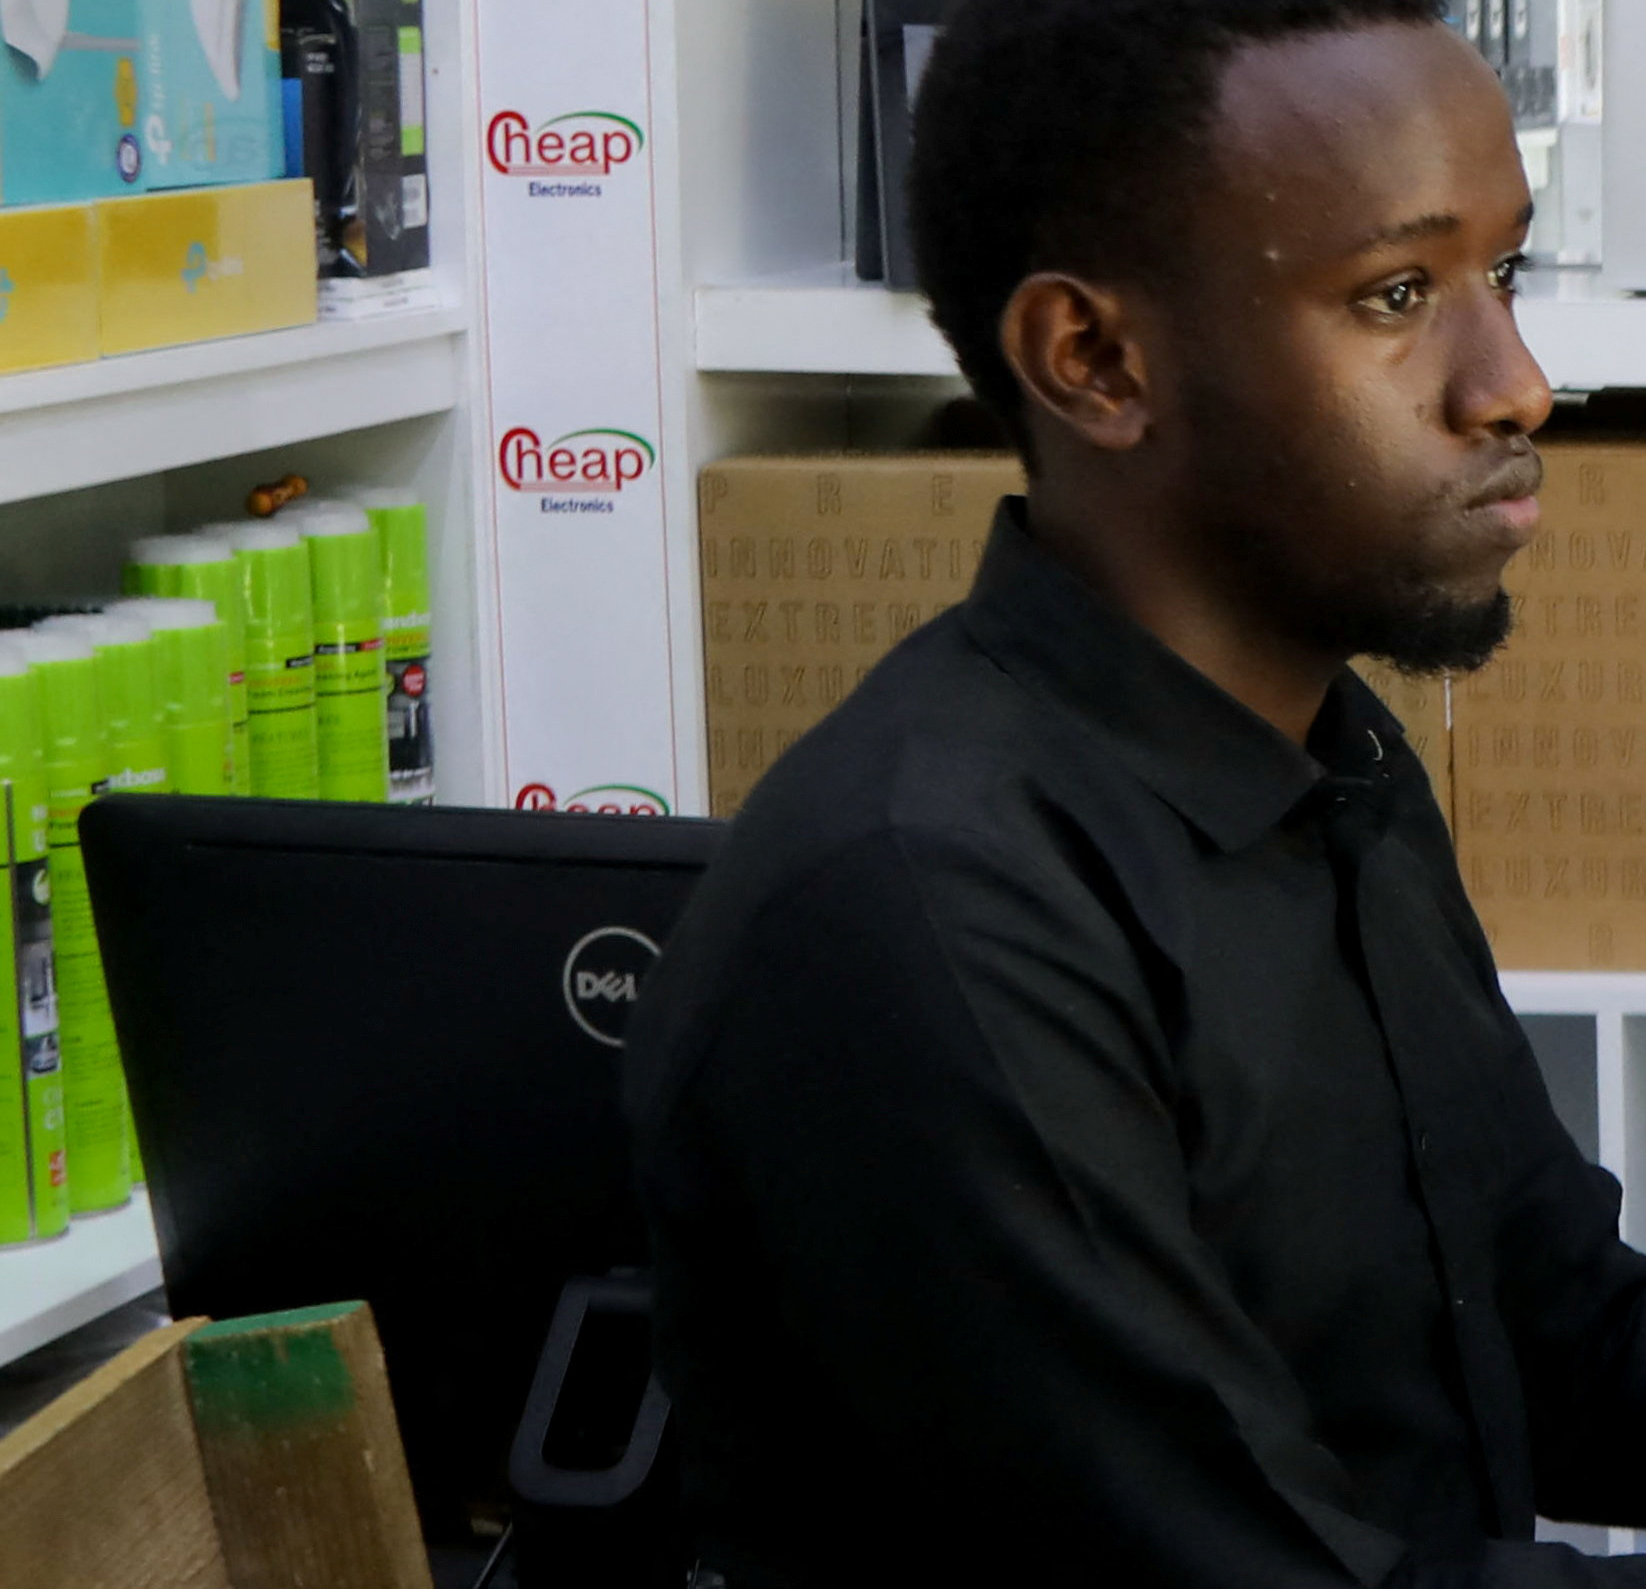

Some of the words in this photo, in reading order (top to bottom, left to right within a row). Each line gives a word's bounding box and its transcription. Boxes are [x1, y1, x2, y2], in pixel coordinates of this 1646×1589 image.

[487, 110, 633, 176] Cheap
[500, 427, 644, 492] Cheap
[576, 970, 639, 1003] DEL
